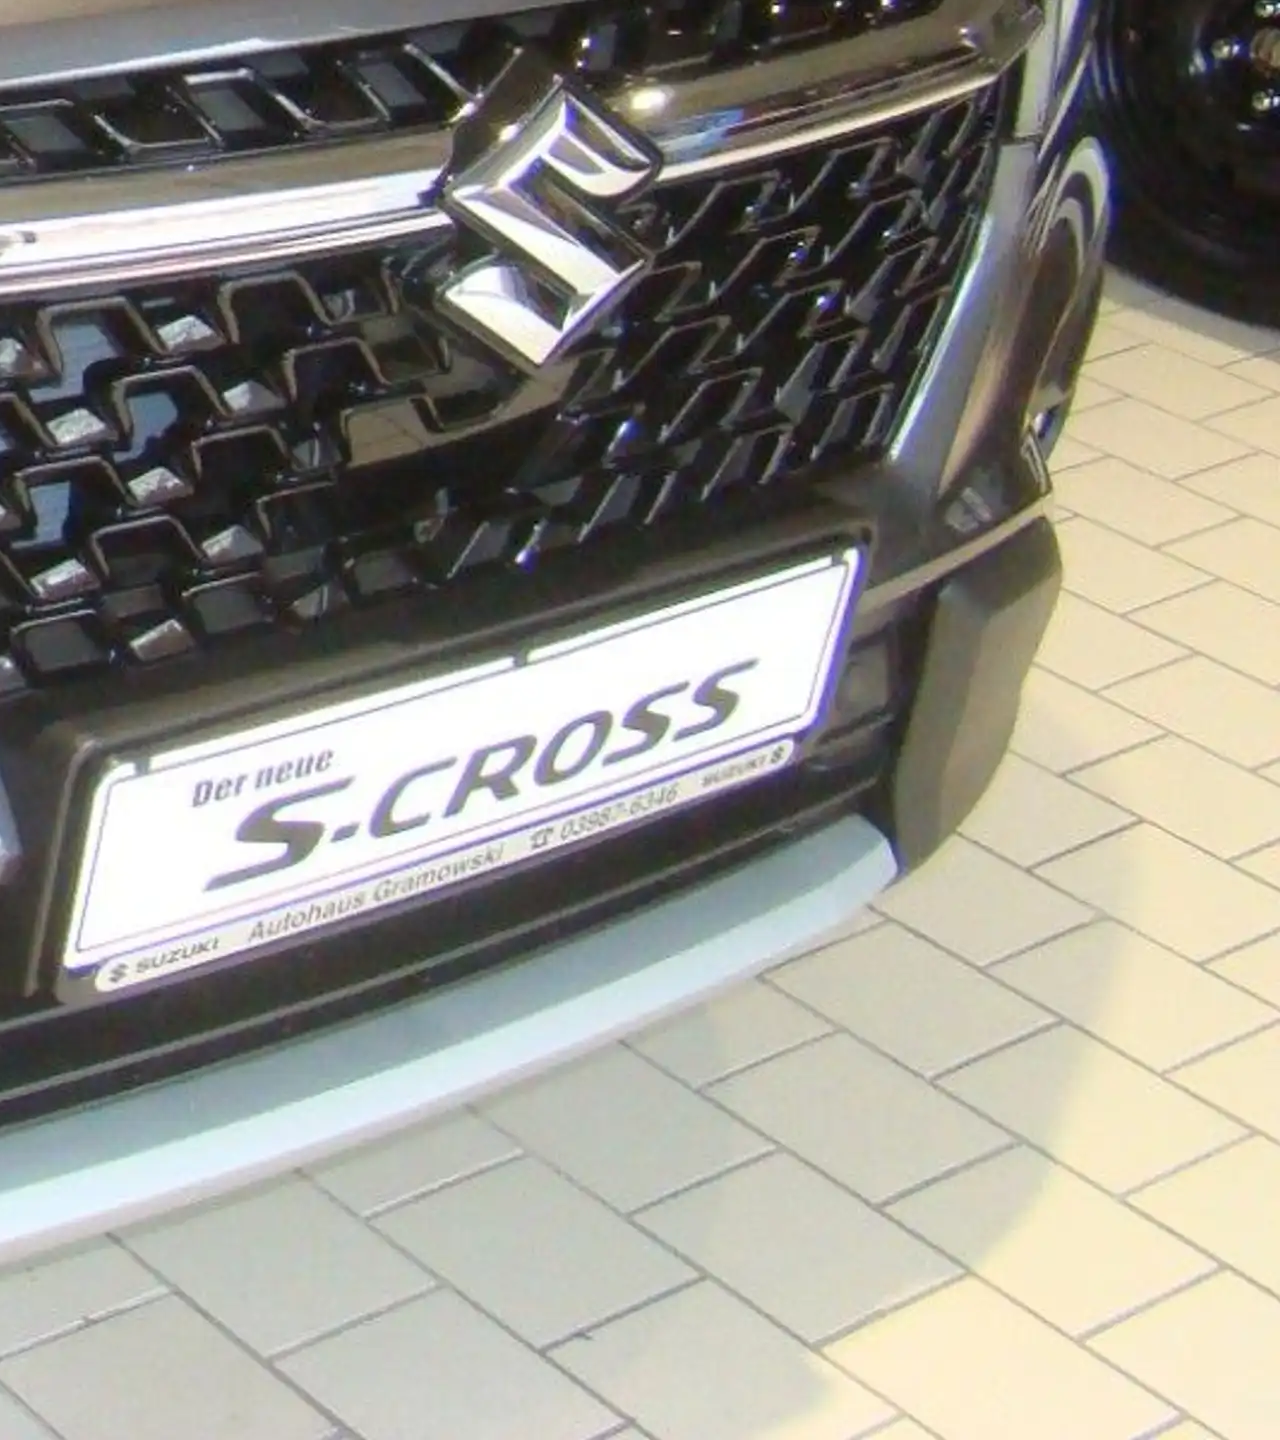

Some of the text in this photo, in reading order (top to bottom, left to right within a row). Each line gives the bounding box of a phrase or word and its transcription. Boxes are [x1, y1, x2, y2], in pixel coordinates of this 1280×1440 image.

[191, 749, 334, 808] Der neue
[135, 936, 221, 975] SUZUKI
[247, 891, 366, 944] Autohaus
[371, 843, 505, 904] Gramowski
